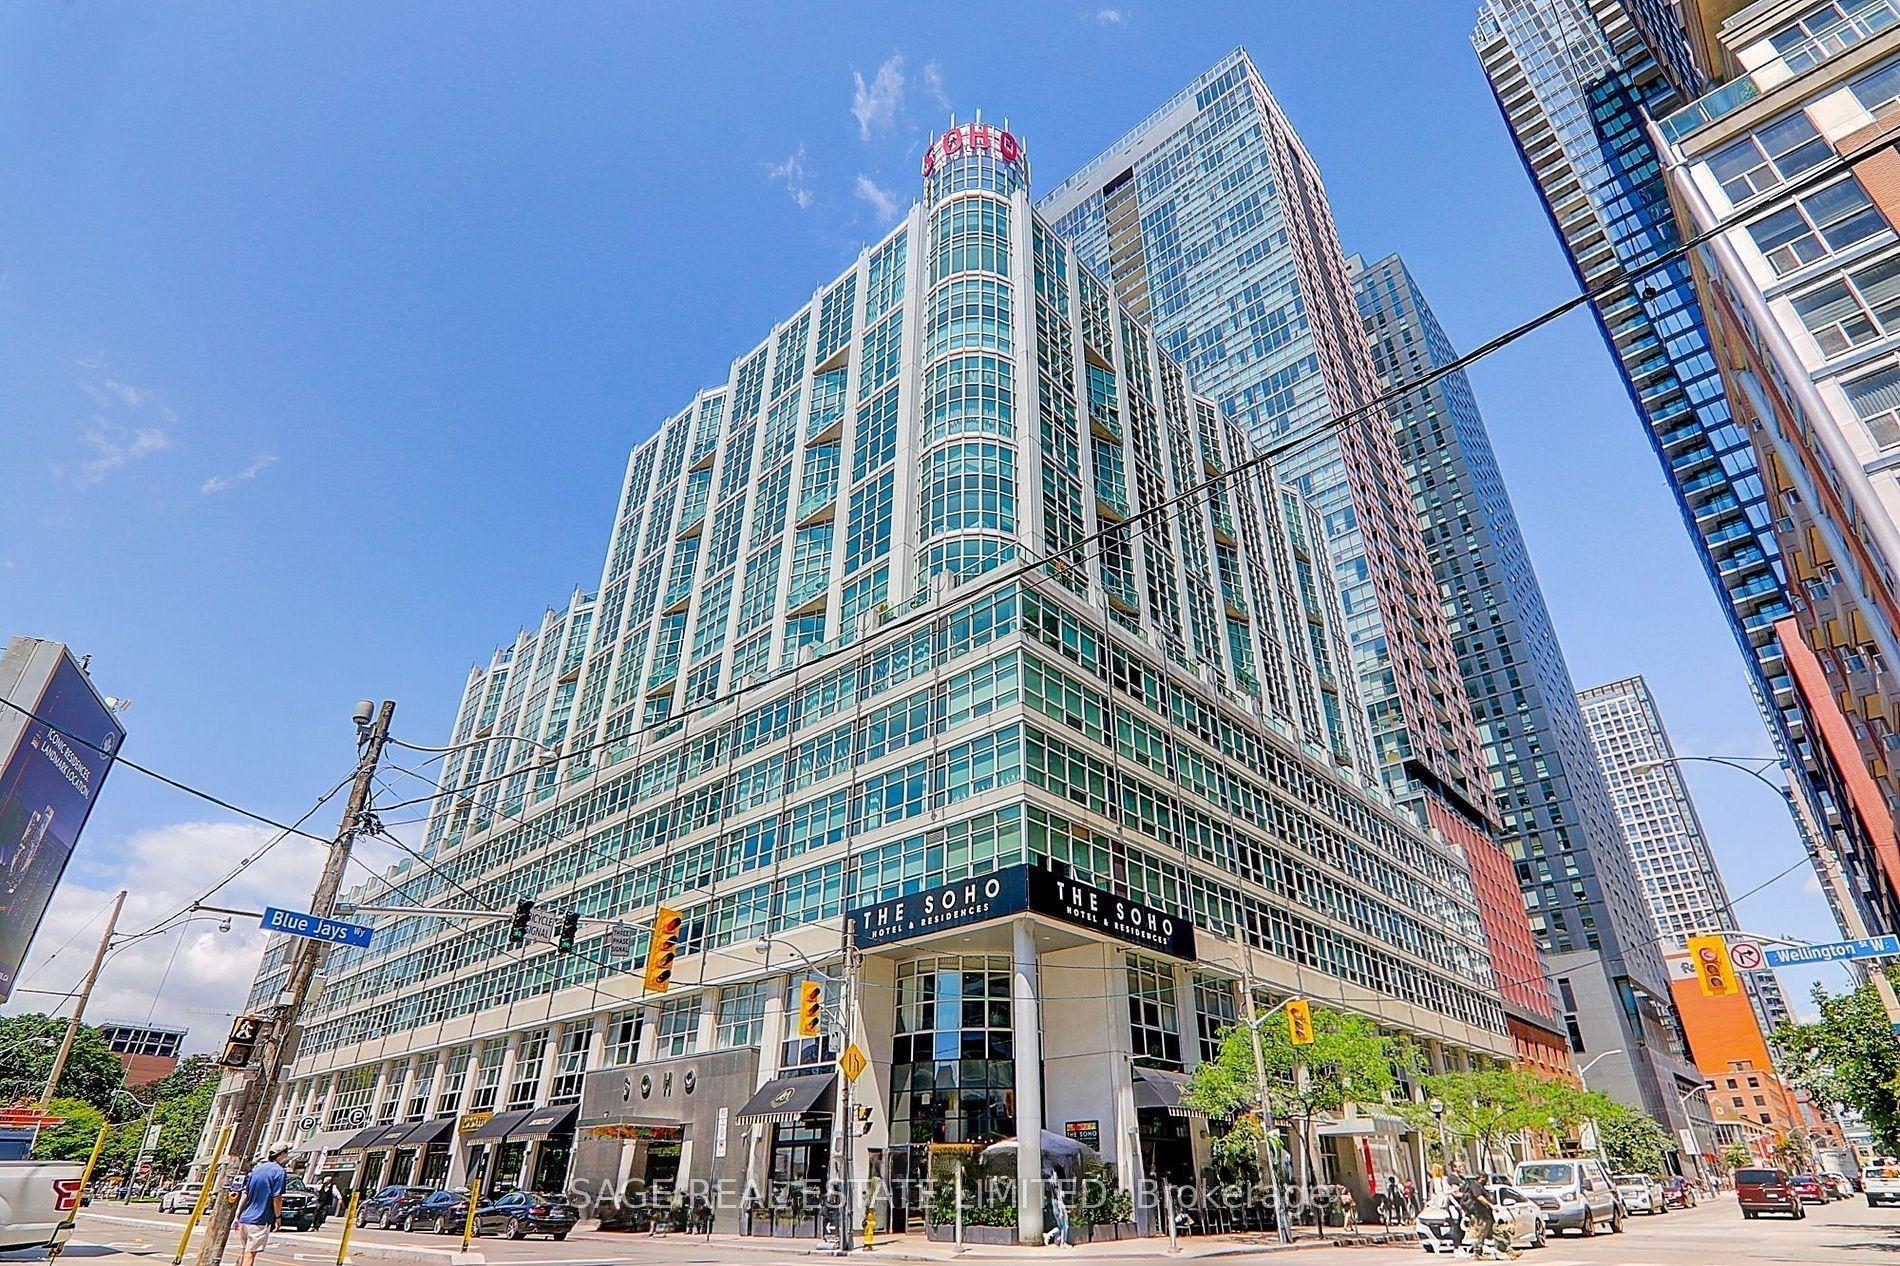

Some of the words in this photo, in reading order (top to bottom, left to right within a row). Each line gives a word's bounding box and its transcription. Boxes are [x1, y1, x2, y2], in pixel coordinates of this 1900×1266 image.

[922, 123, 1018, 177] SOHO
[47, 728, 67, 754] ICONIC
[40, 741, 70, 778] LANDMARK
[530, 912, 553, 926] ICYCLE
[863, 903, 904, 929] THE
[925, 878, 1000, 914] SOHO
[1056, 881, 1098, 911] THE
[1116, 902, 1173, 936] SOHO
[271, 911, 308, 931] Blue
[313, 919, 348, 940] Jays
[353, 927, 366, 938] Wy
[872, 925, 902, 938] HOTEL
[909, 921, 914, 930] &
[921, 903, 989, 927] RESIDENCES
[1066, 906, 1098, 923] HOTEL
[1103, 918, 1109, 926] &
[1114, 921, 1168, 945] RESIDENCES
[1777, 945, 1856, 962] Wellington
[1859, 940, 1868, 949] St
[1869, 939, 1885, 951] W
[623, 1070, 697, 1102] SOHO
[1079, 1130, 1098, 1138] SOHO
